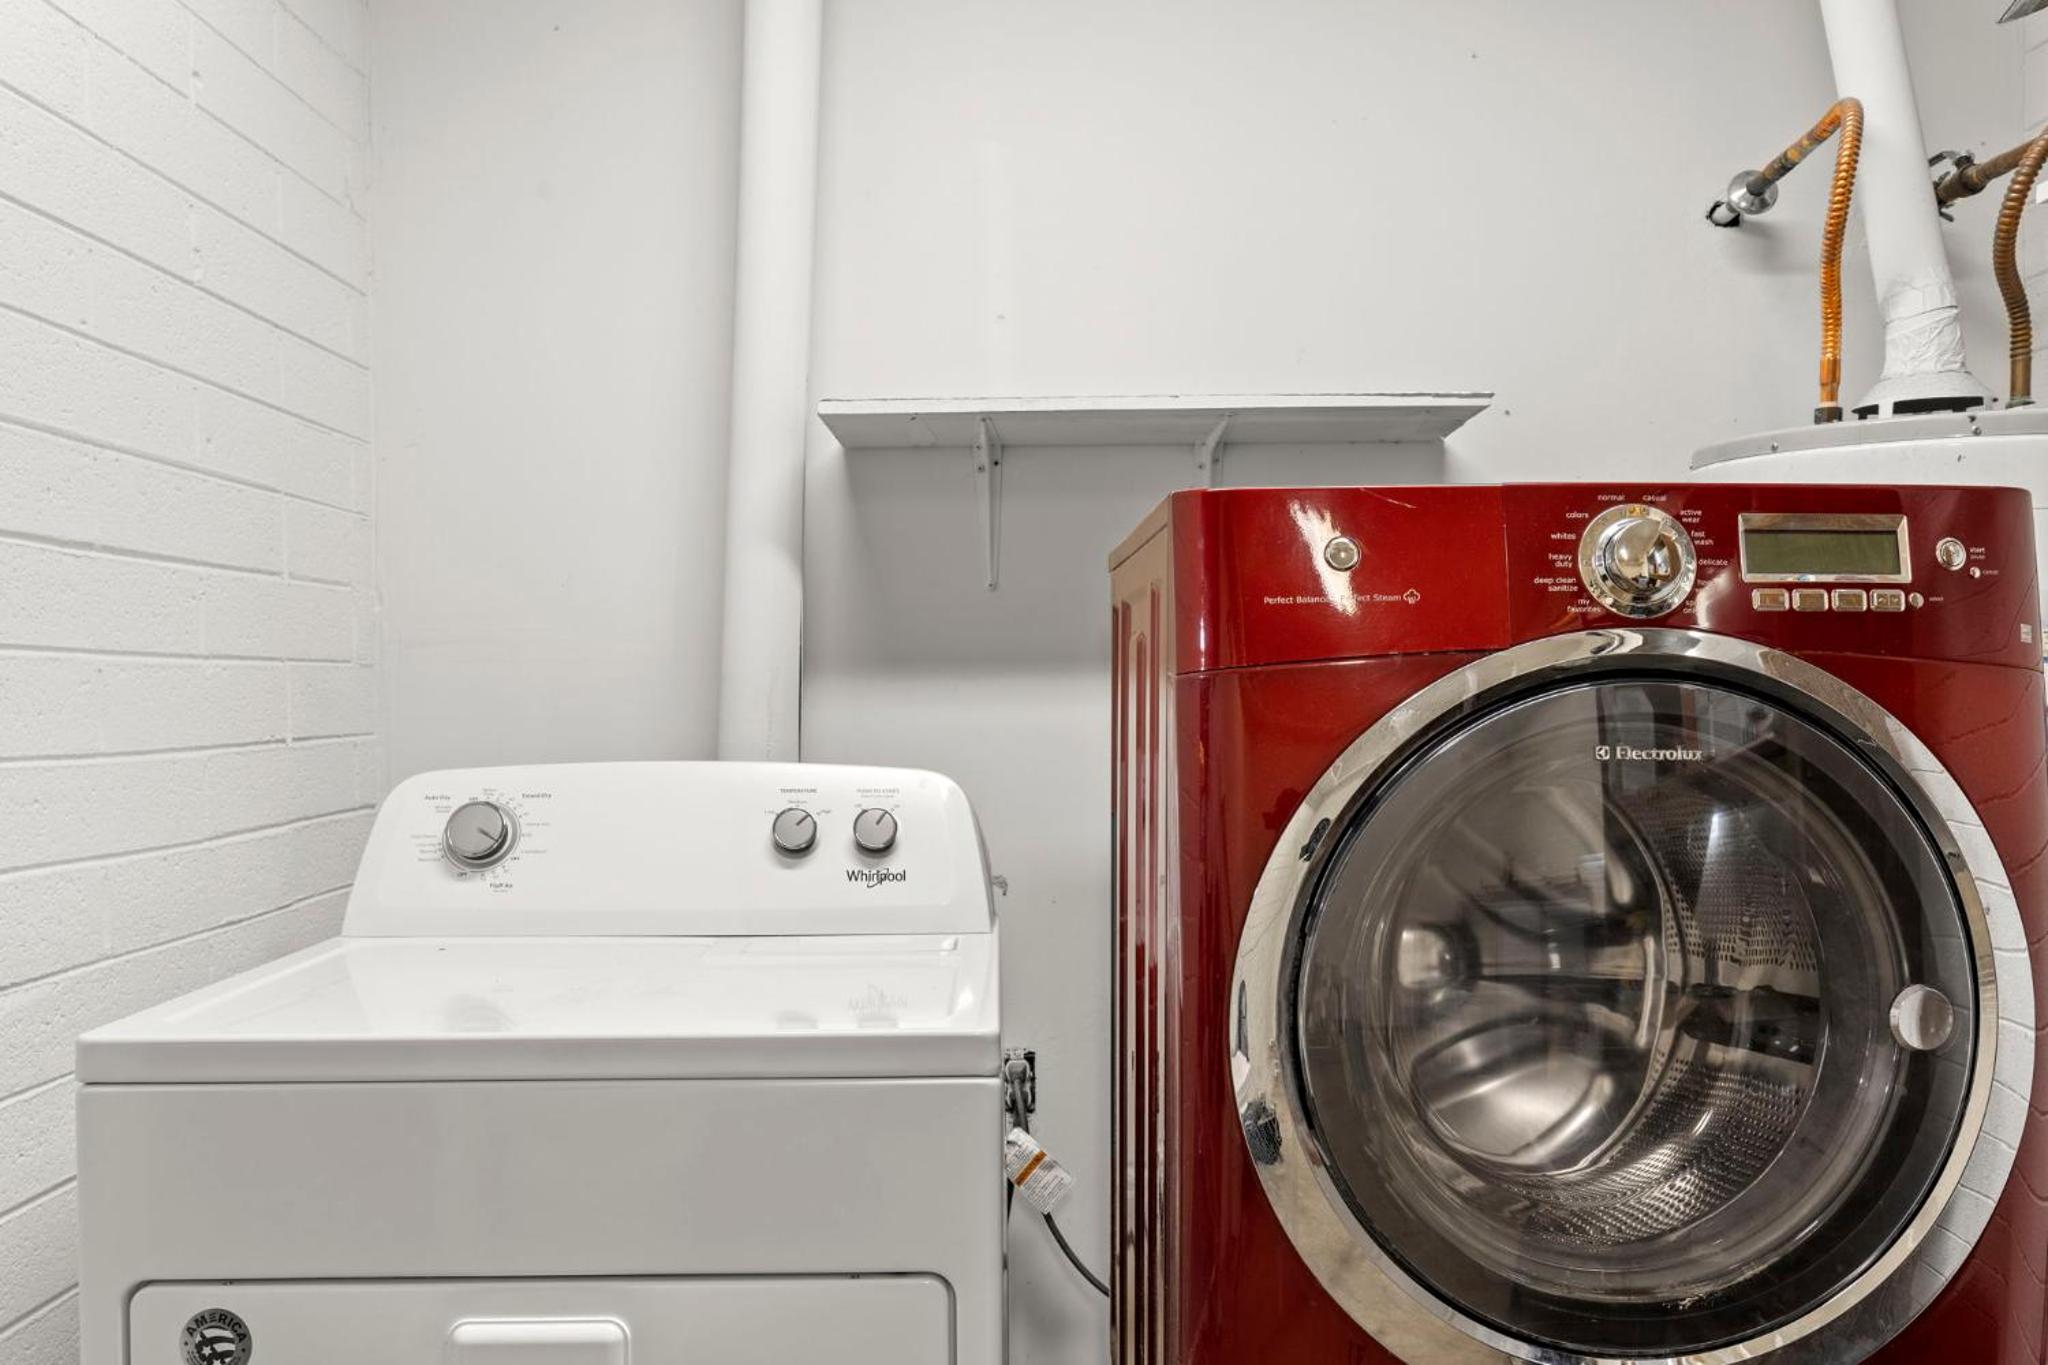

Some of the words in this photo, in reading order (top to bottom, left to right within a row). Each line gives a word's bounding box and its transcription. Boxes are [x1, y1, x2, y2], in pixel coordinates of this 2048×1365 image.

[1565, 511, 1589, 519] colors
[1551, 532, 1577, 540] whites
[1690, 529, 1706, 537] fast
[1548, 553, 1573, 561] heavy
[1554, 561, 1573, 569] duty
[1533, 577, 1554, 585] deep
[1548, 584, 1579, 592] sanitize
[1263, 596, 1294, 605] Perfect
[1373, 593, 1402, 601] Steam
[1577, 598, 1590, 606] my
[1567, 605, 1602, 613] favorites
[1616, 744, 1702, 761] Electrolux
[846, 868, 907, 888] Whirlpool
[186, 1311, 248, 1344] AMERICA
